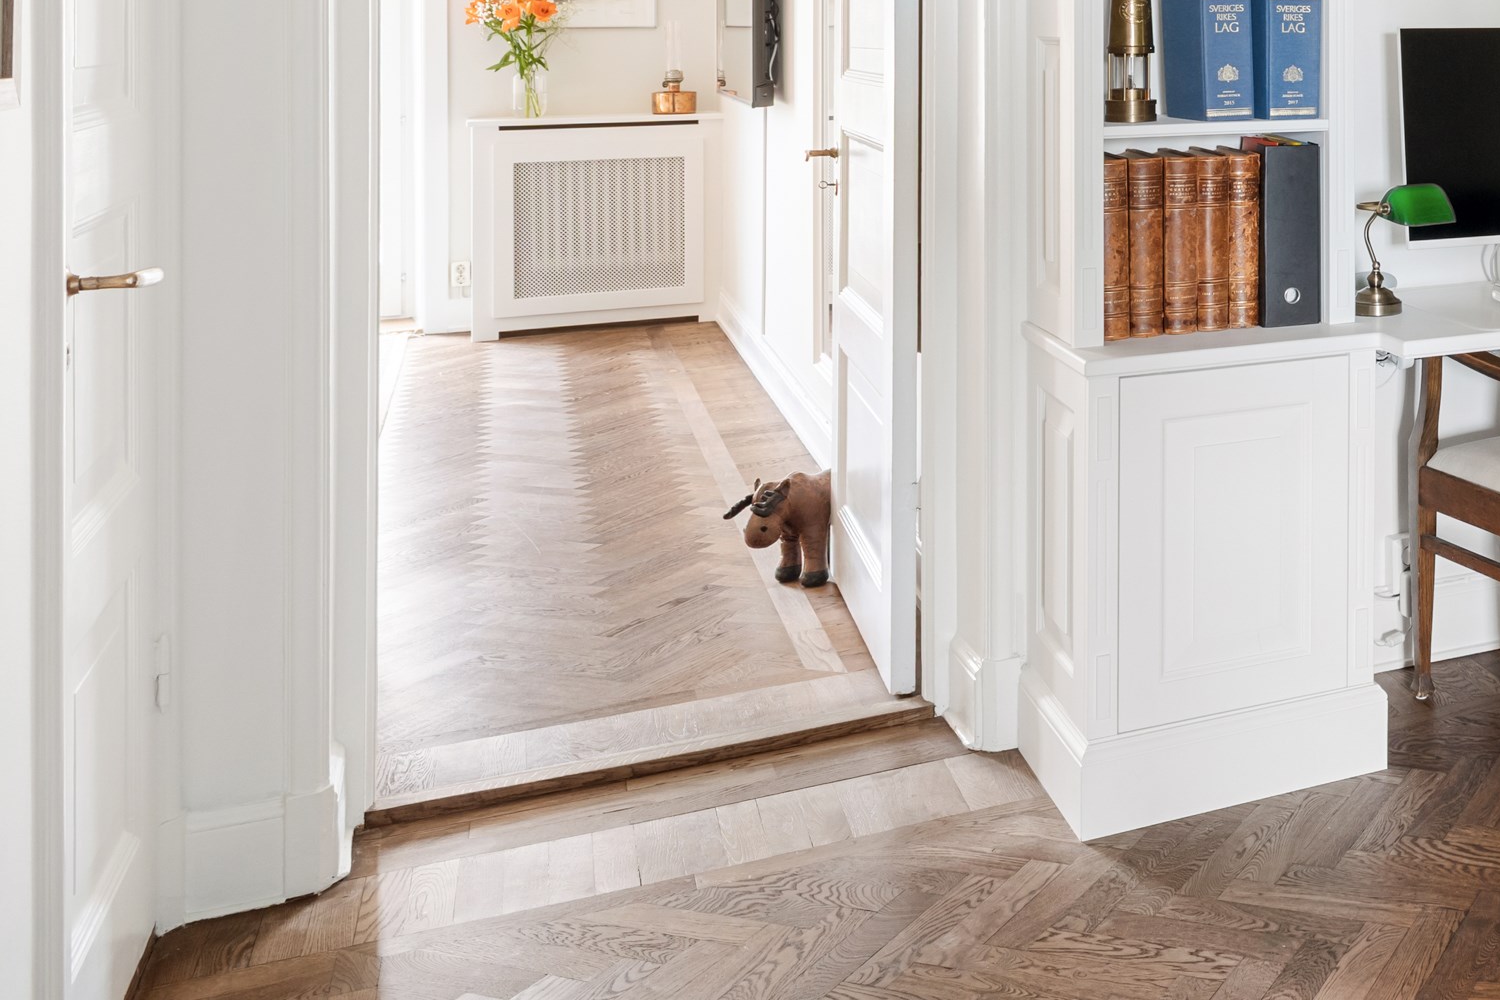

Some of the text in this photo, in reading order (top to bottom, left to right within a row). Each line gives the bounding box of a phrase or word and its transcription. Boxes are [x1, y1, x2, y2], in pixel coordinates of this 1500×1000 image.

[1209, 4, 1244, 13] SVERIGES
[1276, 5, 1311, 13] SVERIGES
[1215, 22, 1239, 32] LAG
[1281, 22, 1305, 33] LAG
